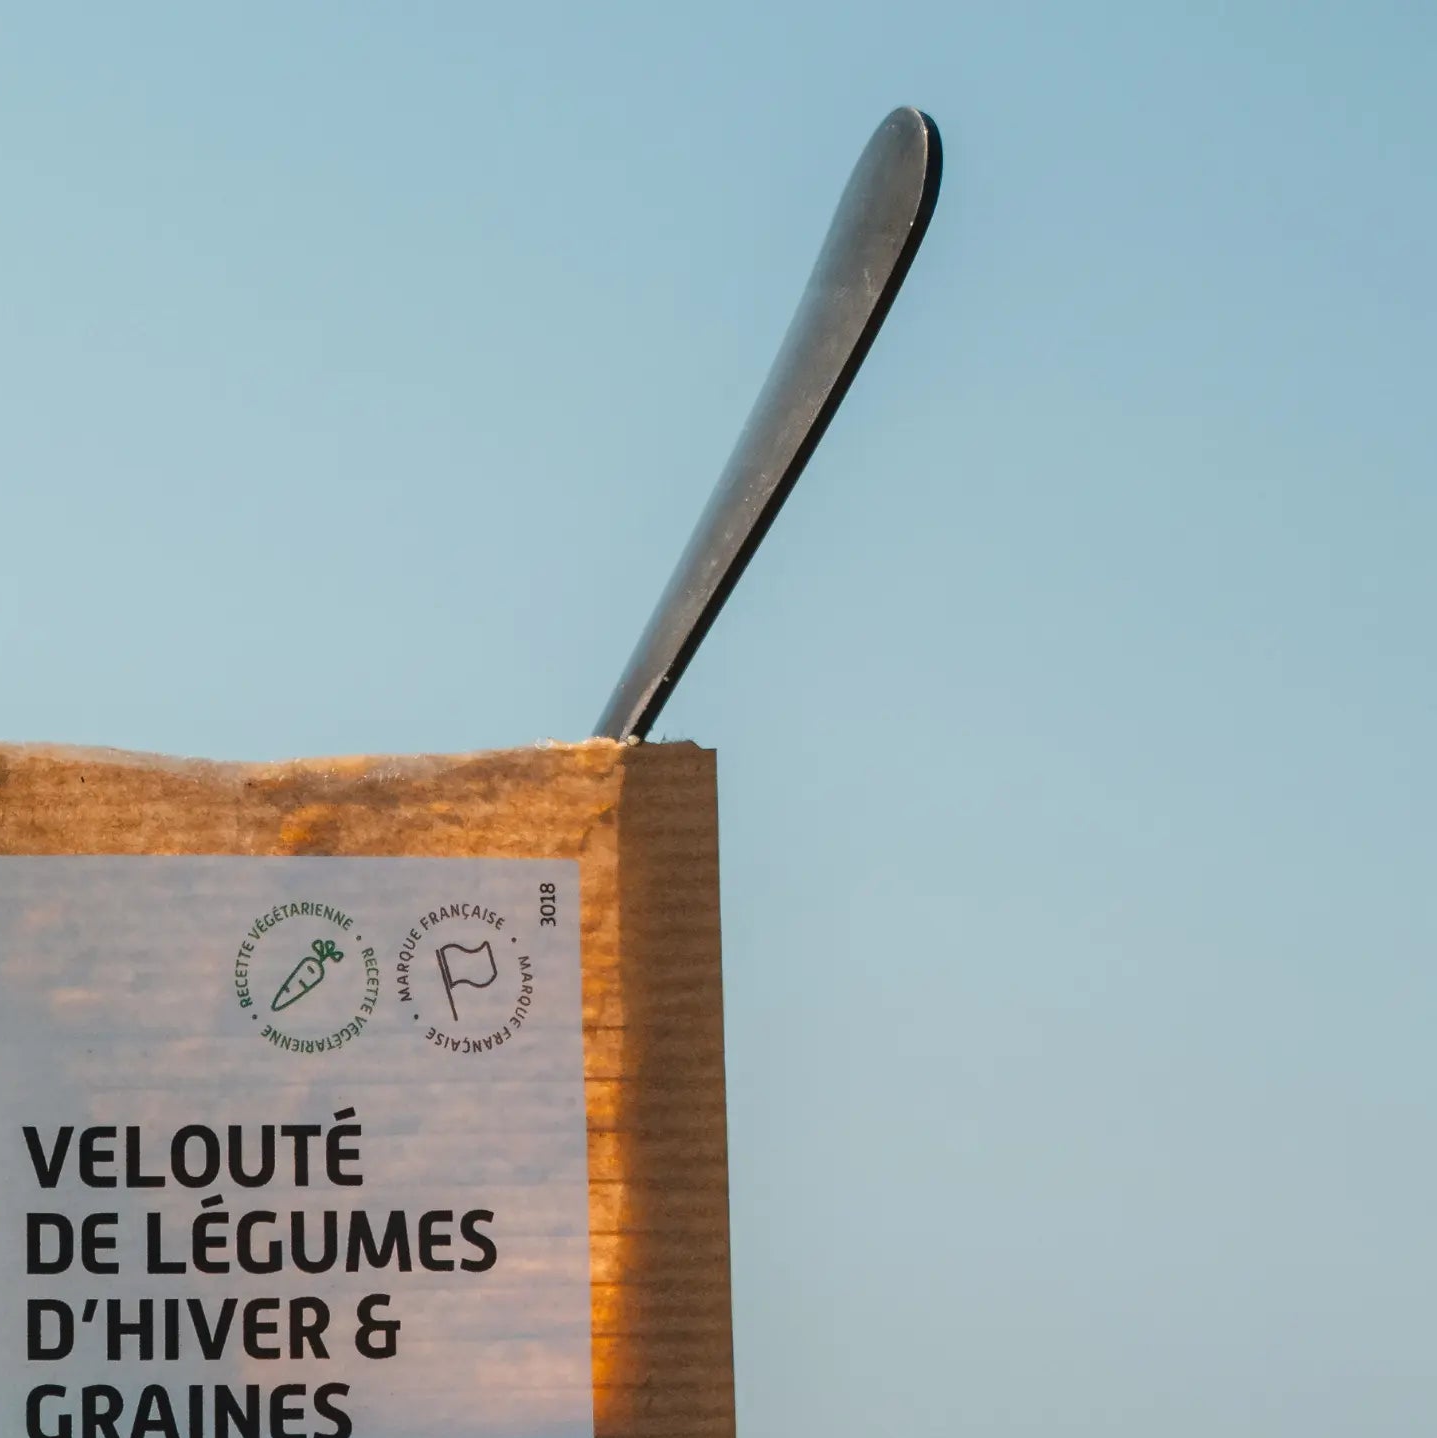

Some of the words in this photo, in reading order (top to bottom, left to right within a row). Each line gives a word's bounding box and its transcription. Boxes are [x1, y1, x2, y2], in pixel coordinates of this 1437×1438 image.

[539, 883, 556, 927] 3018
[234, 941, 255, 1008] RECETTE
[248, 902, 354, 939] VÉGÉTARIENNE
[362, 947, 380, 1015] RECETTE
[397, 928, 422, 1002] MARQUE
[419, 903, 505, 930] FRANÇAISE
[509, 955, 533, 1029] MARQUE
[260, 1016, 368, 1053] VÉGÉTARIENNE
[425, 1026, 512, 1053] FRANÇAISE
[22, 1106, 364, 1188] VELOUTÉ
[26, 1212, 120, 1274] DE
[146, 1194, 498, 1274] LÉGUMES
[27, 1297, 331, 1361] D’HIVER
[355, 1293, 401, 1359] &
